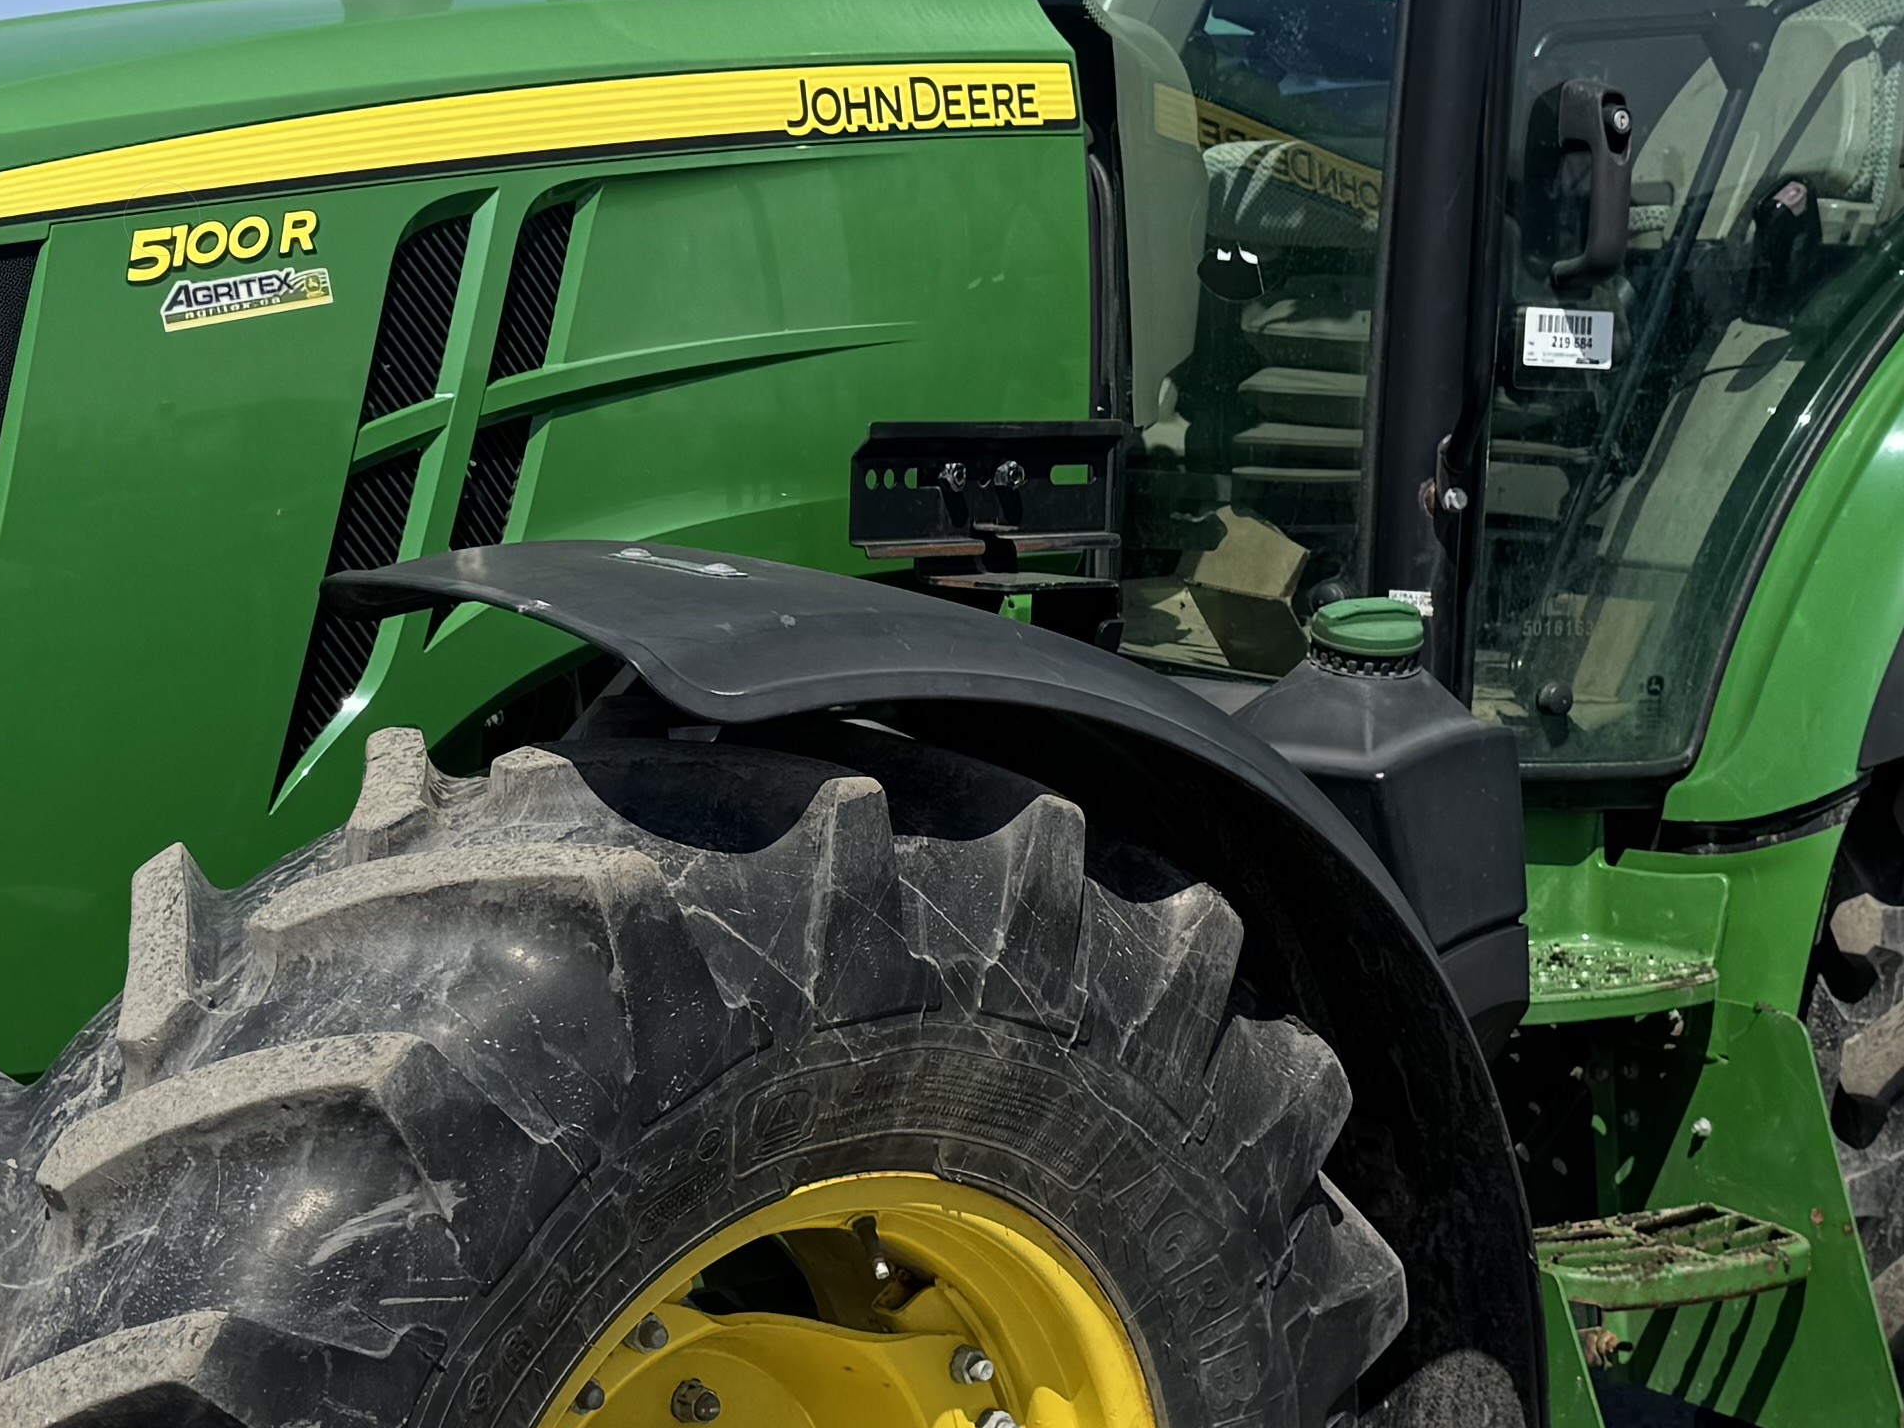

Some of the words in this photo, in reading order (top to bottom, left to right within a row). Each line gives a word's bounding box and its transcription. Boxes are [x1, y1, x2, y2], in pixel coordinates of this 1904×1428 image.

[787, 78, 904, 128] JOHN
[909, 75, 1040, 123] DEERE
[127, 215, 270, 283] 5100
[280, 210, 318, 255] R
[164, 271, 296, 312] AGRITEX
